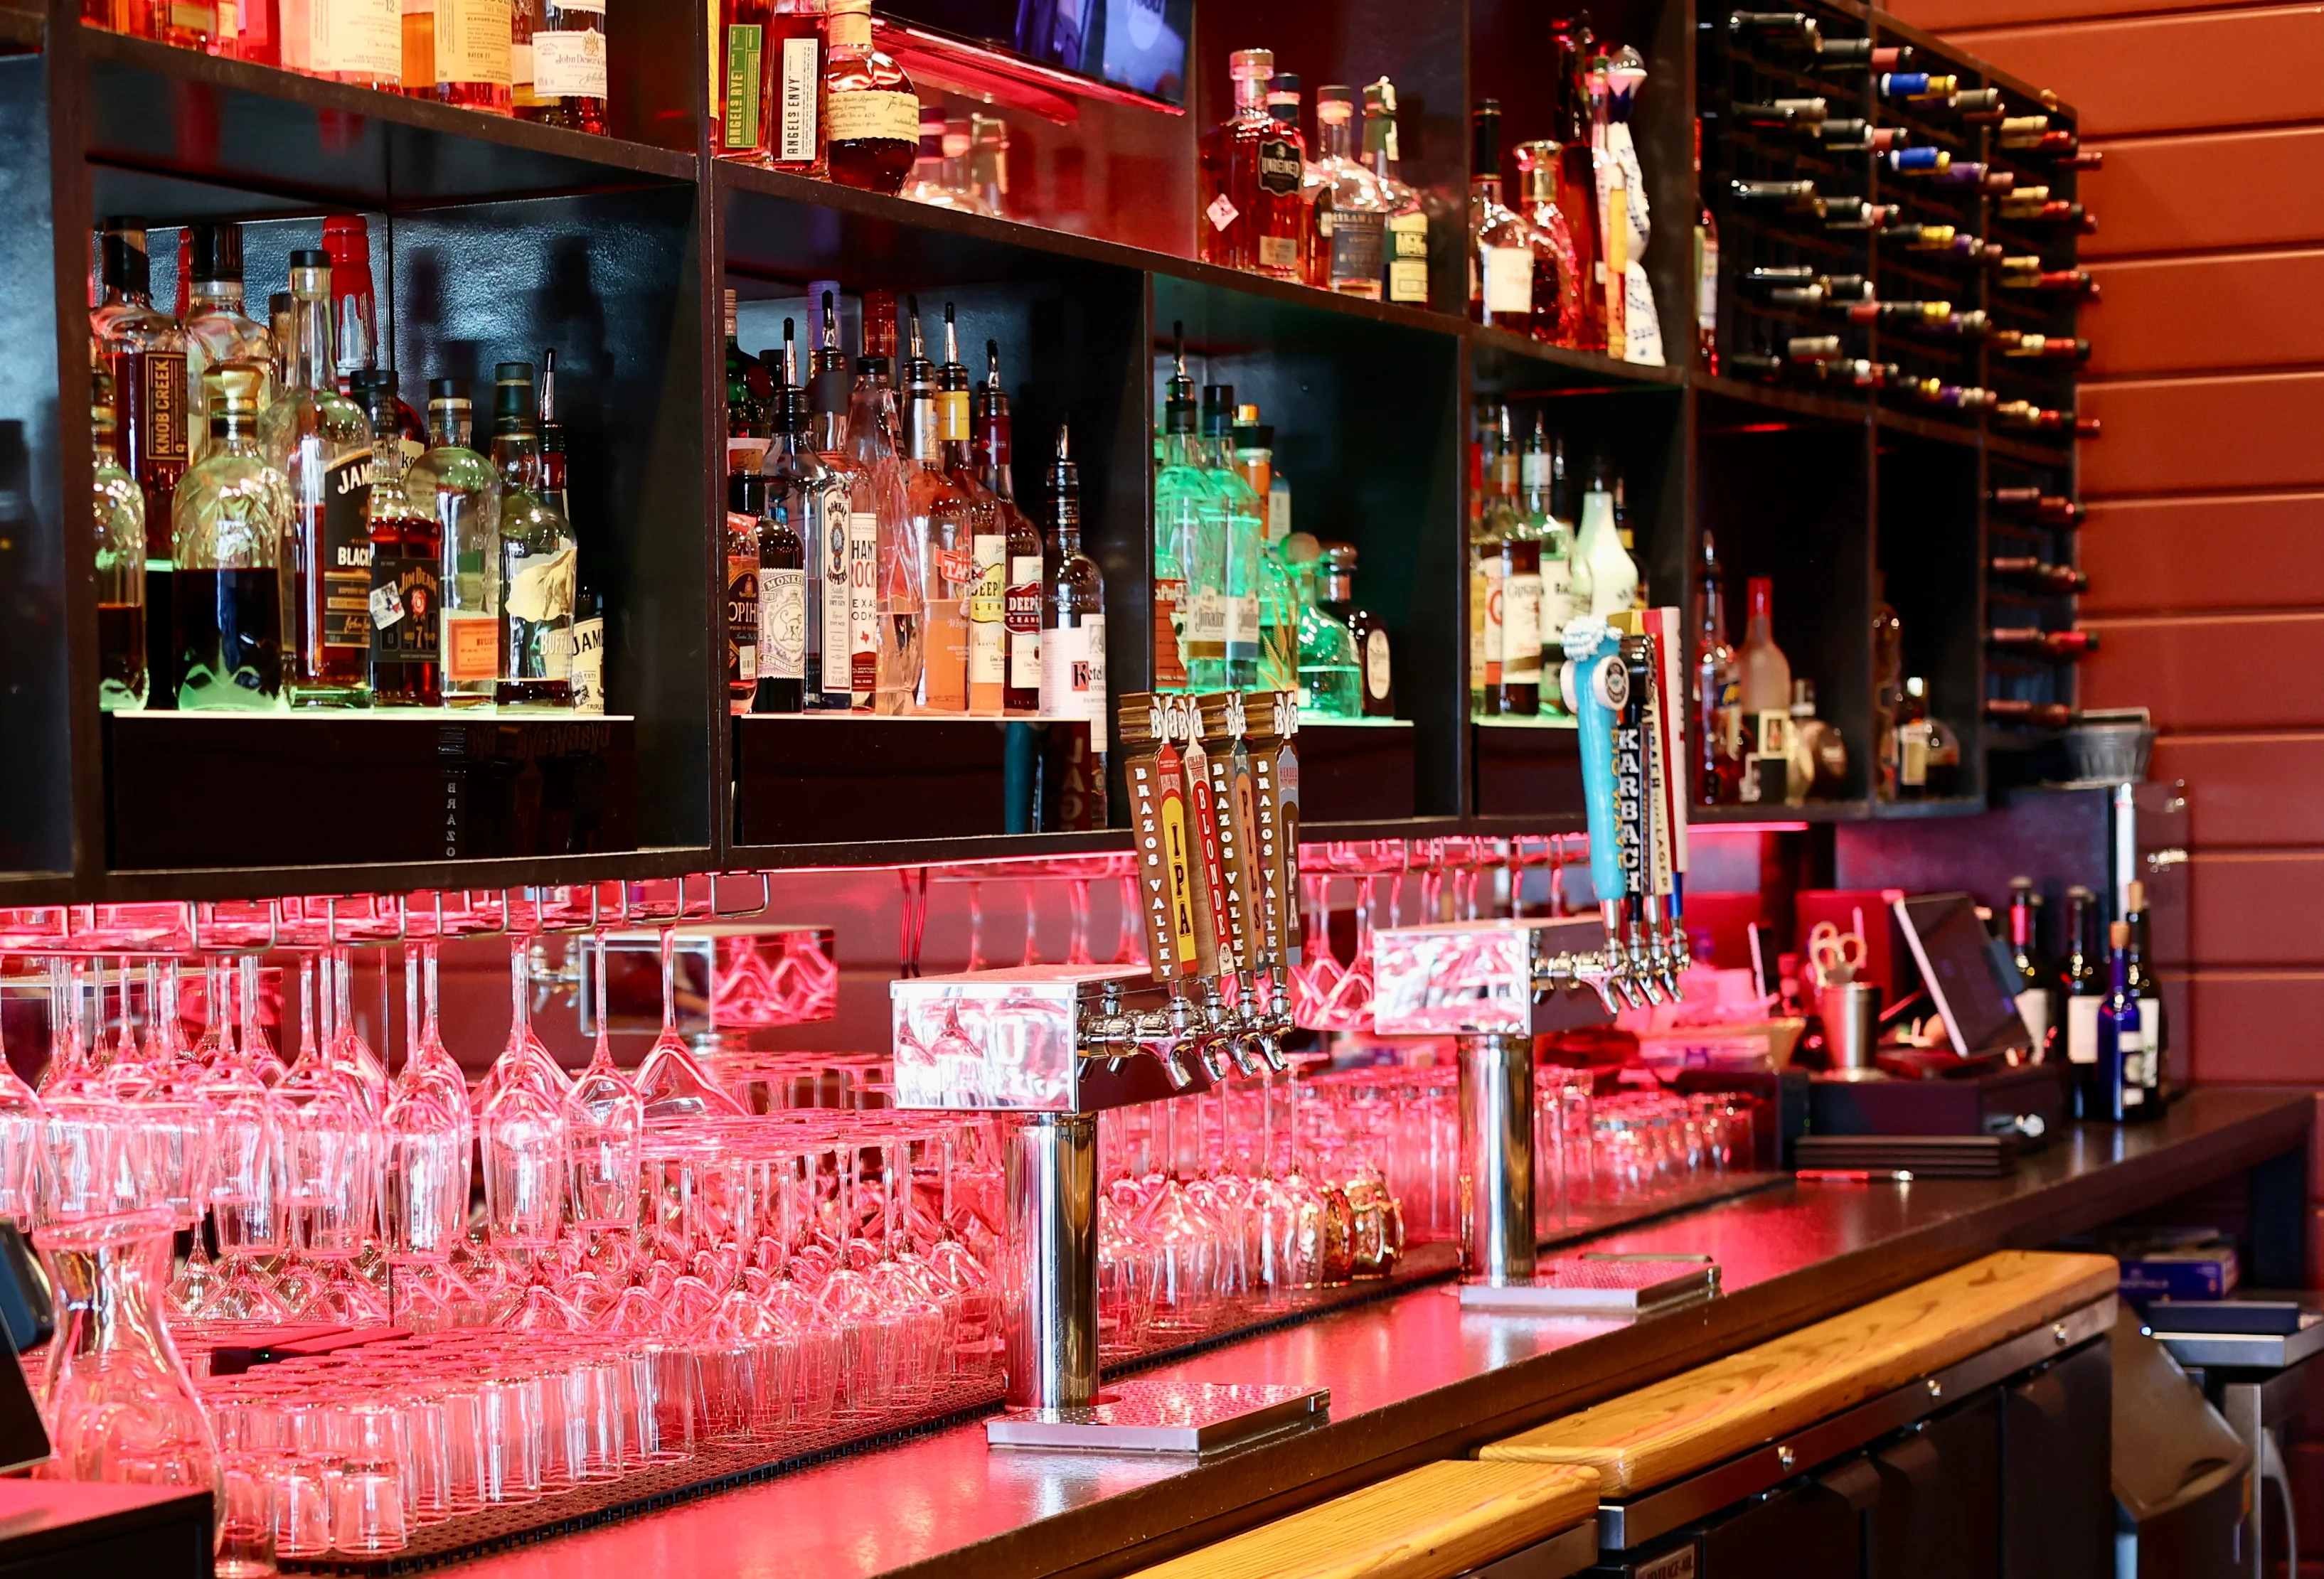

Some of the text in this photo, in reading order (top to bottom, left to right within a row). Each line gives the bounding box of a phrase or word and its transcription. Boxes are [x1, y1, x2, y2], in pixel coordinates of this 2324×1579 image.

[555, 54, 576, 64] John
[730, 72, 744, 96] RYE
[729, 100, 742, 144] ANGELS
[787, 77, 801, 155] ANGELS ENVY
[154, 358, 170, 454] KNOB CREEK
[826, 501, 847, 520] BOMBAY
[399, 566, 438, 597] JIM BEAM
[1008, 596, 1035, 612] DEEP
[415, 625, 423, 649] 7
[1618, 728, 1641, 893] KARBACH
[1134, 767, 1172, 977] BRAZOS VALLEY
[1171, 821, 1192, 938] IPA
[1197, 787, 1225, 938] BLONDE
[1212, 762, 1246, 968] BRAZOS VALLEY
[1240, 789, 1262, 932] PILS
[1257, 759, 1280, 964] BRAZOS VALLEY
[1286, 820, 1299, 931] IPA
